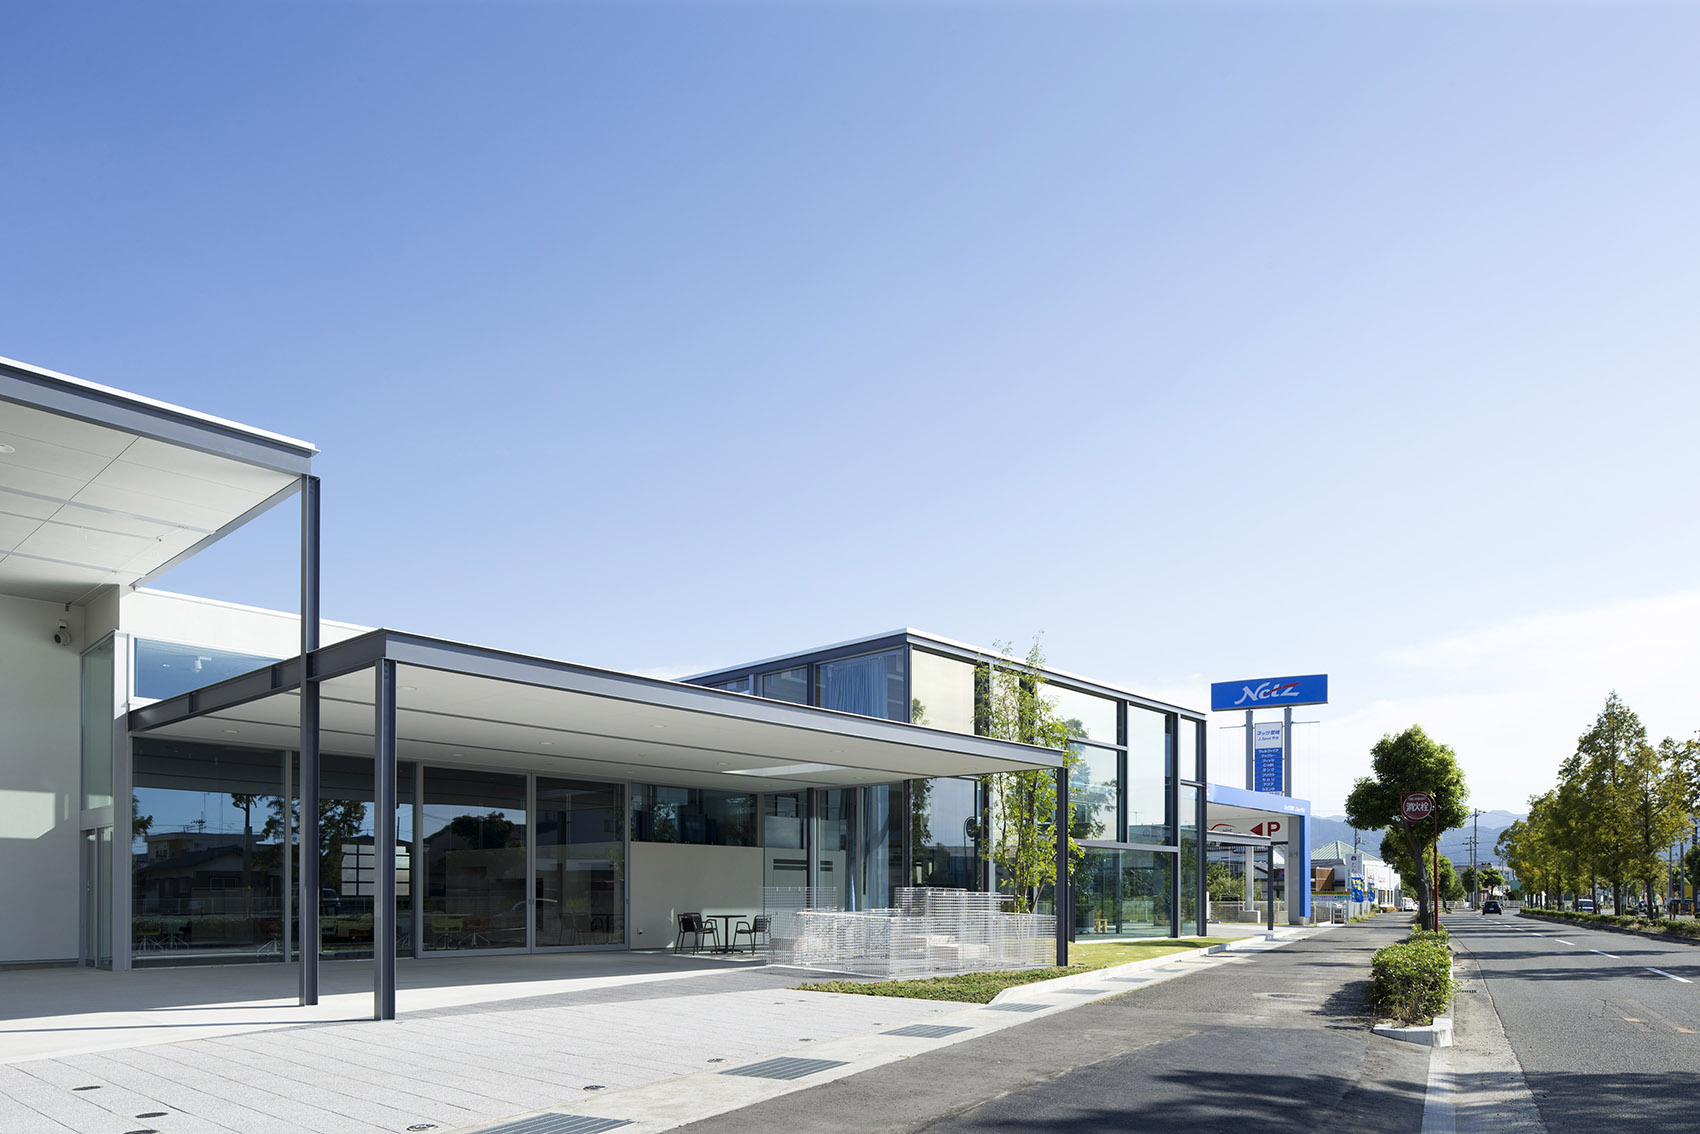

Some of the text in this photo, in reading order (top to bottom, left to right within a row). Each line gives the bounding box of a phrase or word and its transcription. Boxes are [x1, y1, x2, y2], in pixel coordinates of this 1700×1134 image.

[1233, 682, 1301, 705] Netz
[1406, 801, 1429, 811] 消火栓
[1267, 821, 1281, 836] P
